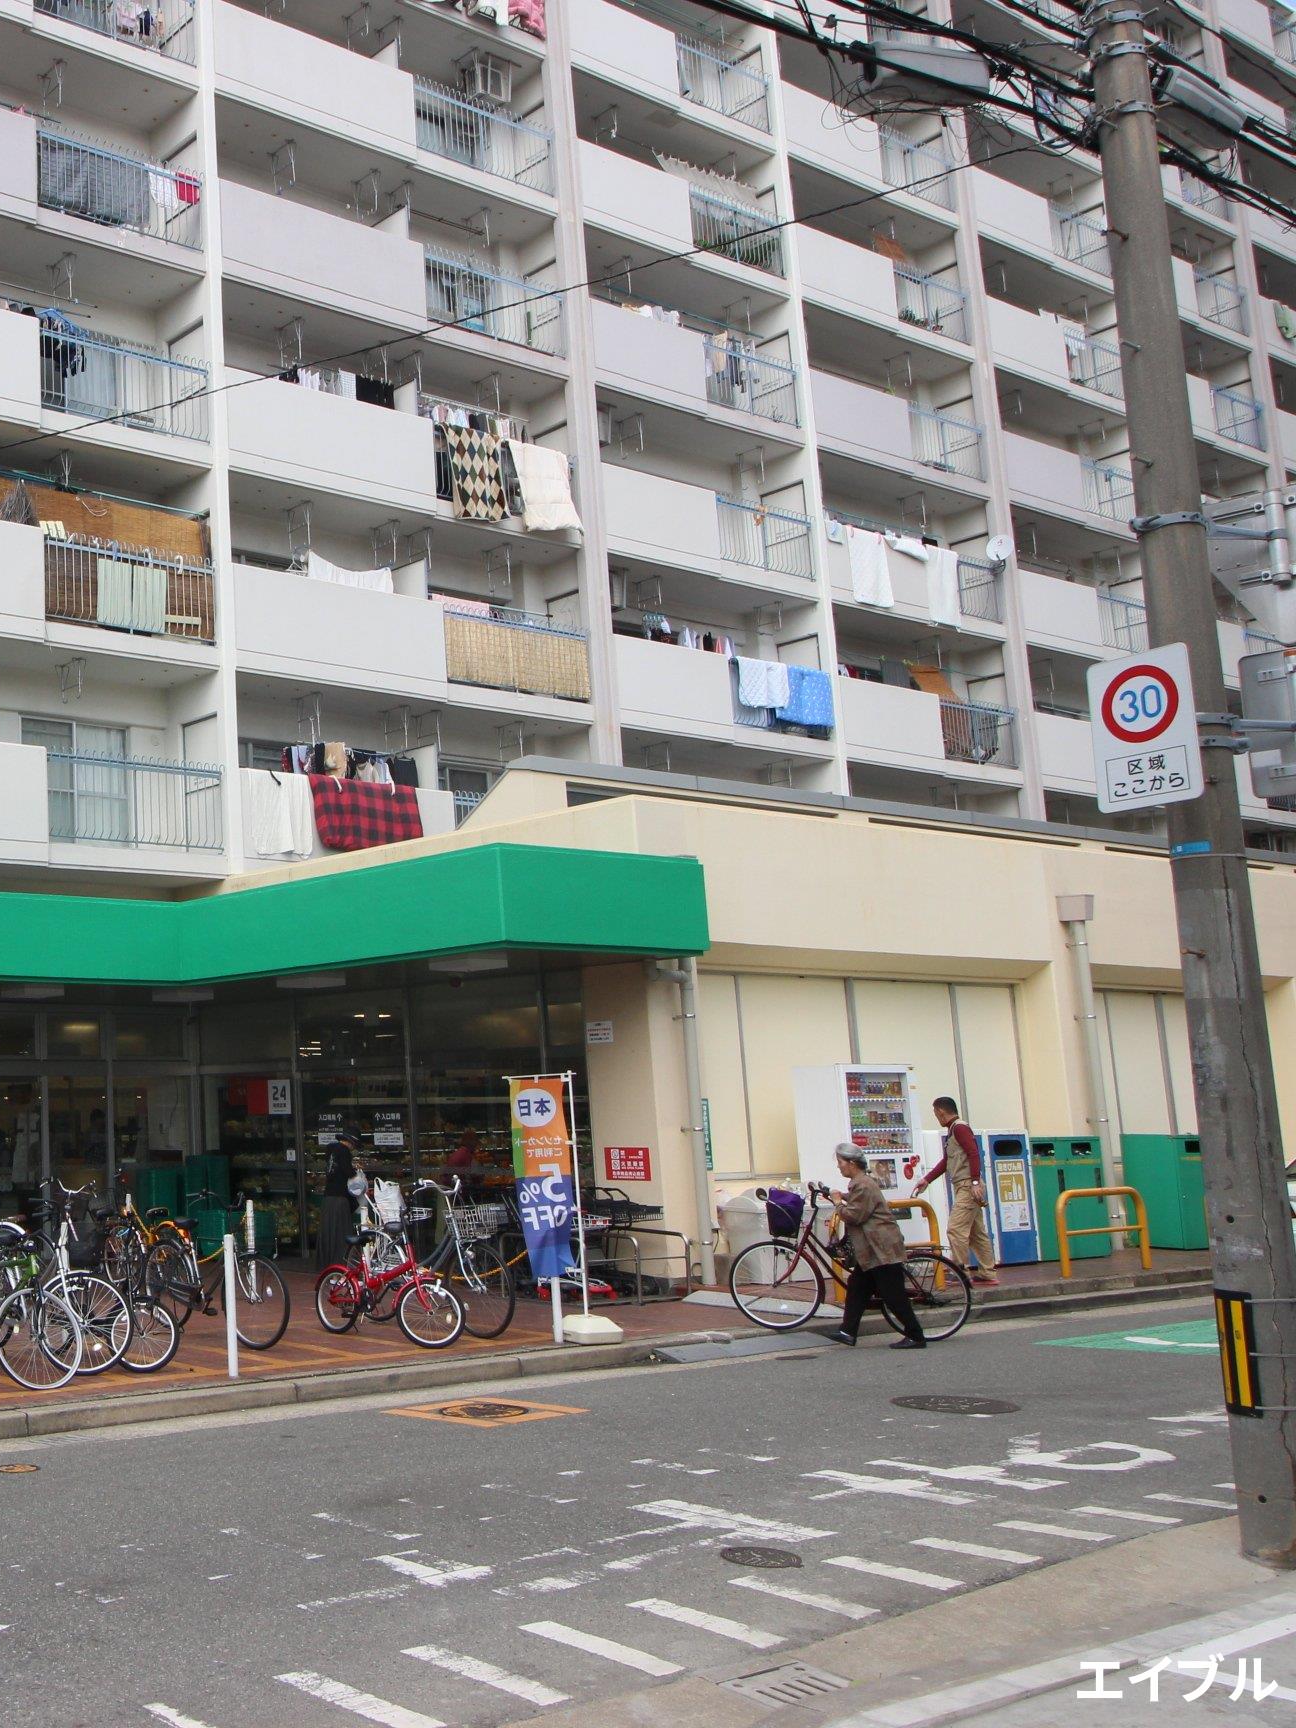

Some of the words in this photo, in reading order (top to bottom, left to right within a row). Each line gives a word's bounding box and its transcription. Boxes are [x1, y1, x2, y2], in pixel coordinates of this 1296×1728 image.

[1118, 684, 1162, 723] 30
[1127, 753, 1165, 775] 区域
[1114, 772, 1185, 797] ここから
[272, 1085, 287, 1101] 24
